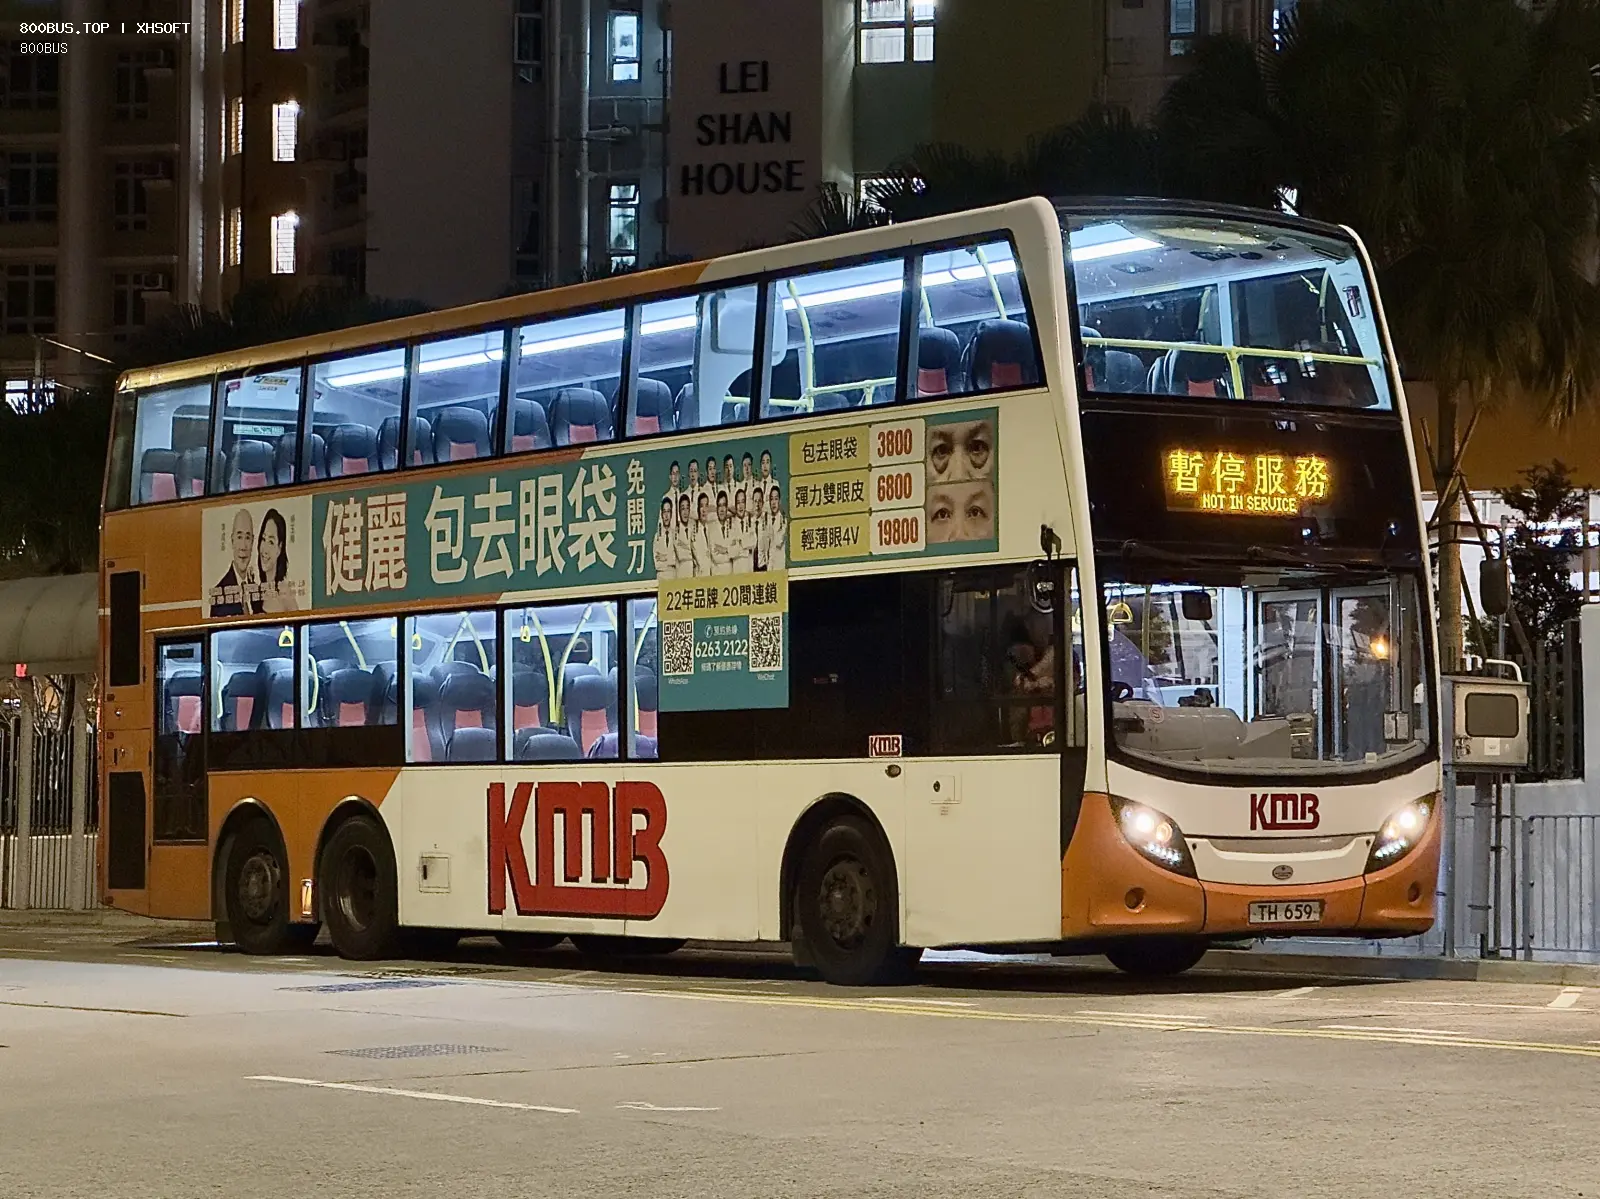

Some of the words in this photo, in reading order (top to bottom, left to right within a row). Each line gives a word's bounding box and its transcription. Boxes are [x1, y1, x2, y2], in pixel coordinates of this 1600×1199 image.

[720, 60, 769, 94] LEI
[696, 111, 792, 146] SHAN
[681, 160, 805, 196] HOUSE
[802, 436, 858, 464] 包去眼袋
[877, 428, 913, 458] 3800
[795, 479, 864, 509] 彈力雙眼皮
[877, 472, 912, 502] 6800
[1169, 448, 1328, 498] 暫停服務
[626, 458, 646, 575] 免開刀
[1203, 493, 1226, 510] NOT
[1230, 494, 1244, 510] IN
[1247, 495, 1298, 513] SERVICE
[322, 492, 408, 596] 健麗
[423, 464, 618, 585] 包去眼袋
[801, 525, 860, 551] 輕薄眼4V
[877, 516, 919, 547] 19800
[666, 587, 719, 612] 22年品牌
[722, 581, 778, 607] 20間連鎖
[695, 640, 721, 658] 6263
[723, 638, 748, 656] 2122
[869, 736, 901, 757] KMB
[1250, 793, 1320, 831] KMB
[486, 781, 670, 921] KMB
[1257, 904, 1278, 921] TH
[1284, 904, 1313, 920] 659
